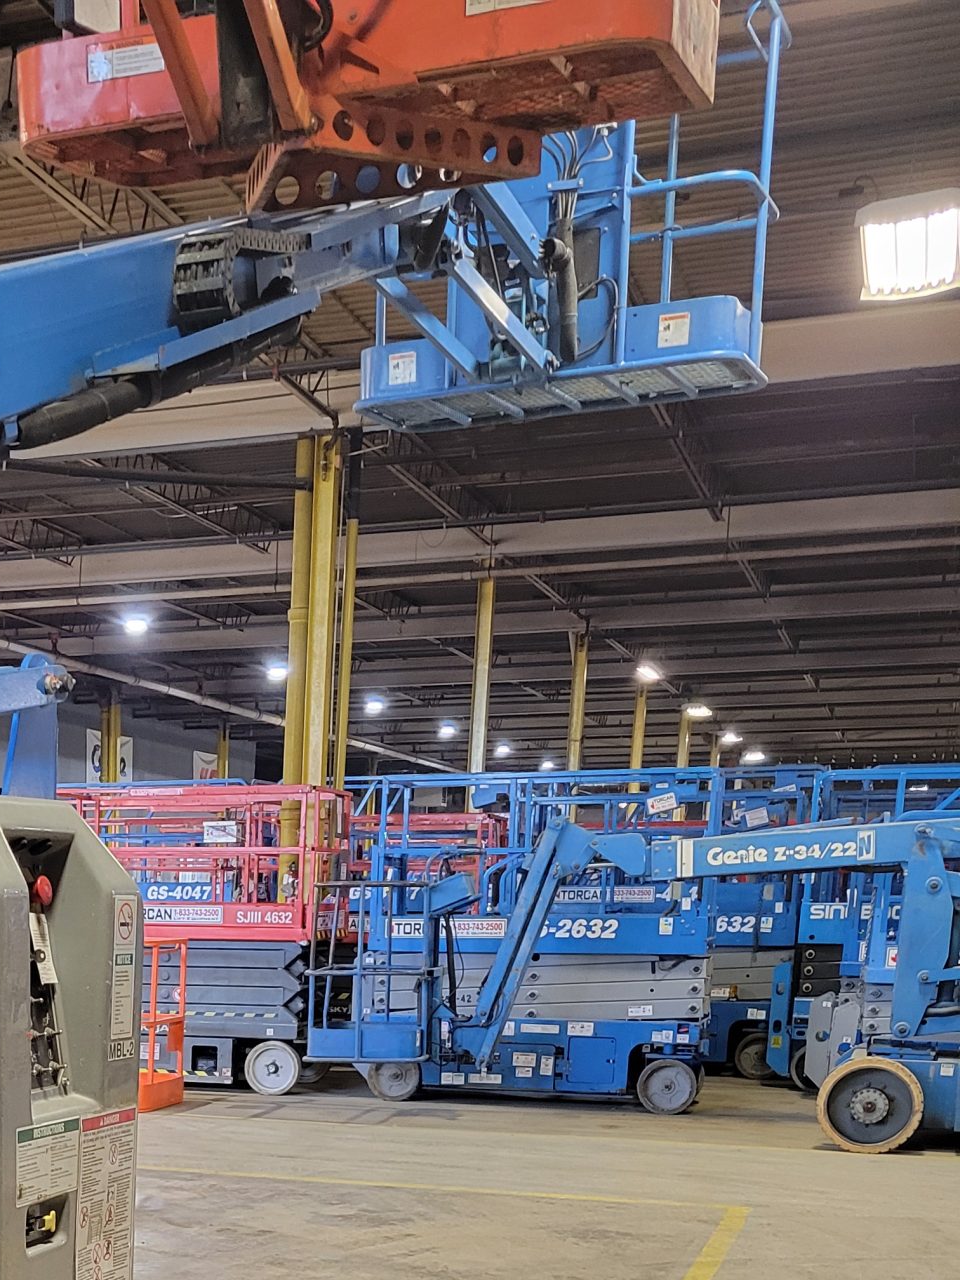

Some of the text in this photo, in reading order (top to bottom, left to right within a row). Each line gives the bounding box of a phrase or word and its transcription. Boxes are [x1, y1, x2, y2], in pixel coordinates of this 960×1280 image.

[707, 840, 768, 866] Genie
[147, 885, 212, 900] GS-4047
[560, 889, 603, 900] TORCA
[236, 911, 292, 924] SJIII 4632
[453, 923, 502, 931] -833-743-2500
[109, 1041, 135, 1060] MBL-2
